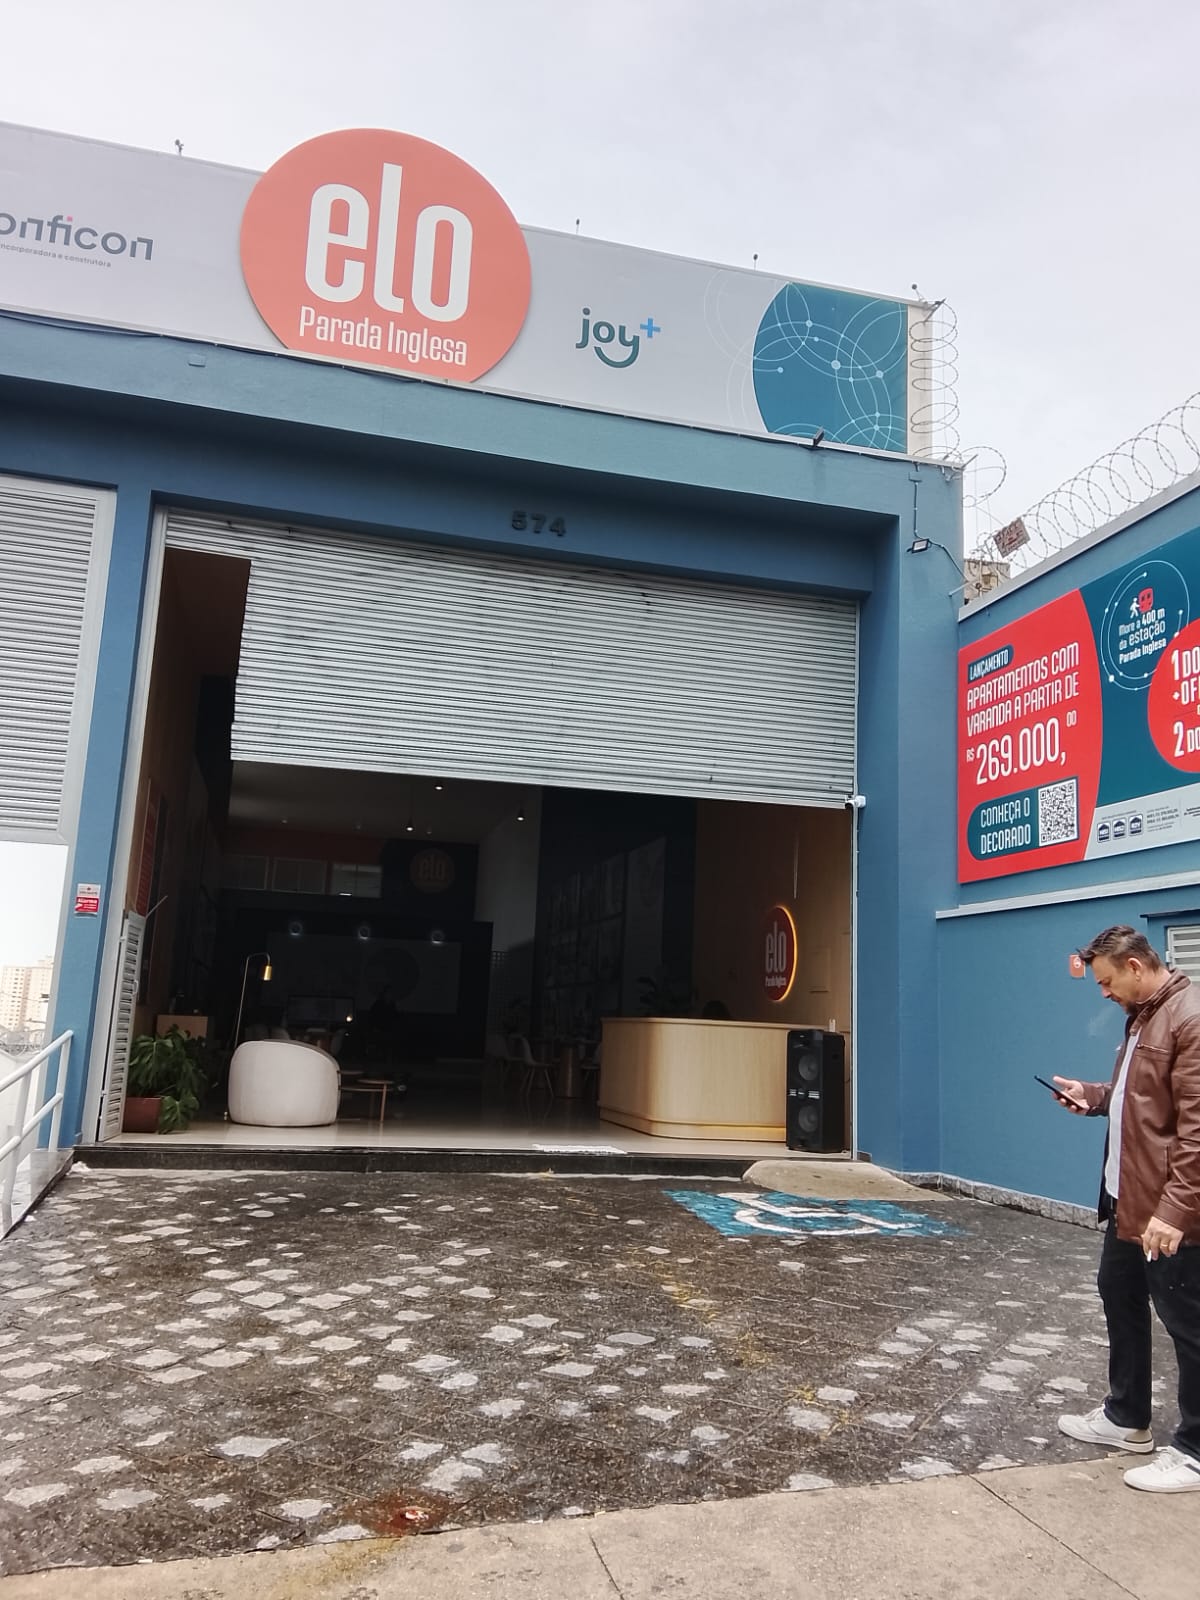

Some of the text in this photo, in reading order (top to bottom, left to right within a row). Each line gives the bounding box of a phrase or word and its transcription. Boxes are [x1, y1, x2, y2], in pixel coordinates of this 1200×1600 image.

[304, 162, 473, 323] elo
[64, 254, 112, 268] construtora
[299, 305, 468, 366] Parada Inglesa
[511, 511, 567, 537] 574
[1141, 609, 1156, 625] 400
[1157, 608, 1166, 619] m
[1119, 620, 1166, 651] da estação
[1119, 638, 1167, 665] Parada Inglesa
[967, 642, 1079, 711] APARTAMENTOS COM
[969, 649, 1009, 681] LANÇAMENTO
[1171, 649, 1179, 681] 1
[967, 671, 1079, 737] VARANDA A PARTIR DE
[1173, 721, 1184, 757] 2
[980, 797, 1031, 828] CONHEÇA O
[980, 823, 1031, 855] DECORADO
[765, 920, 787, 974] elo
